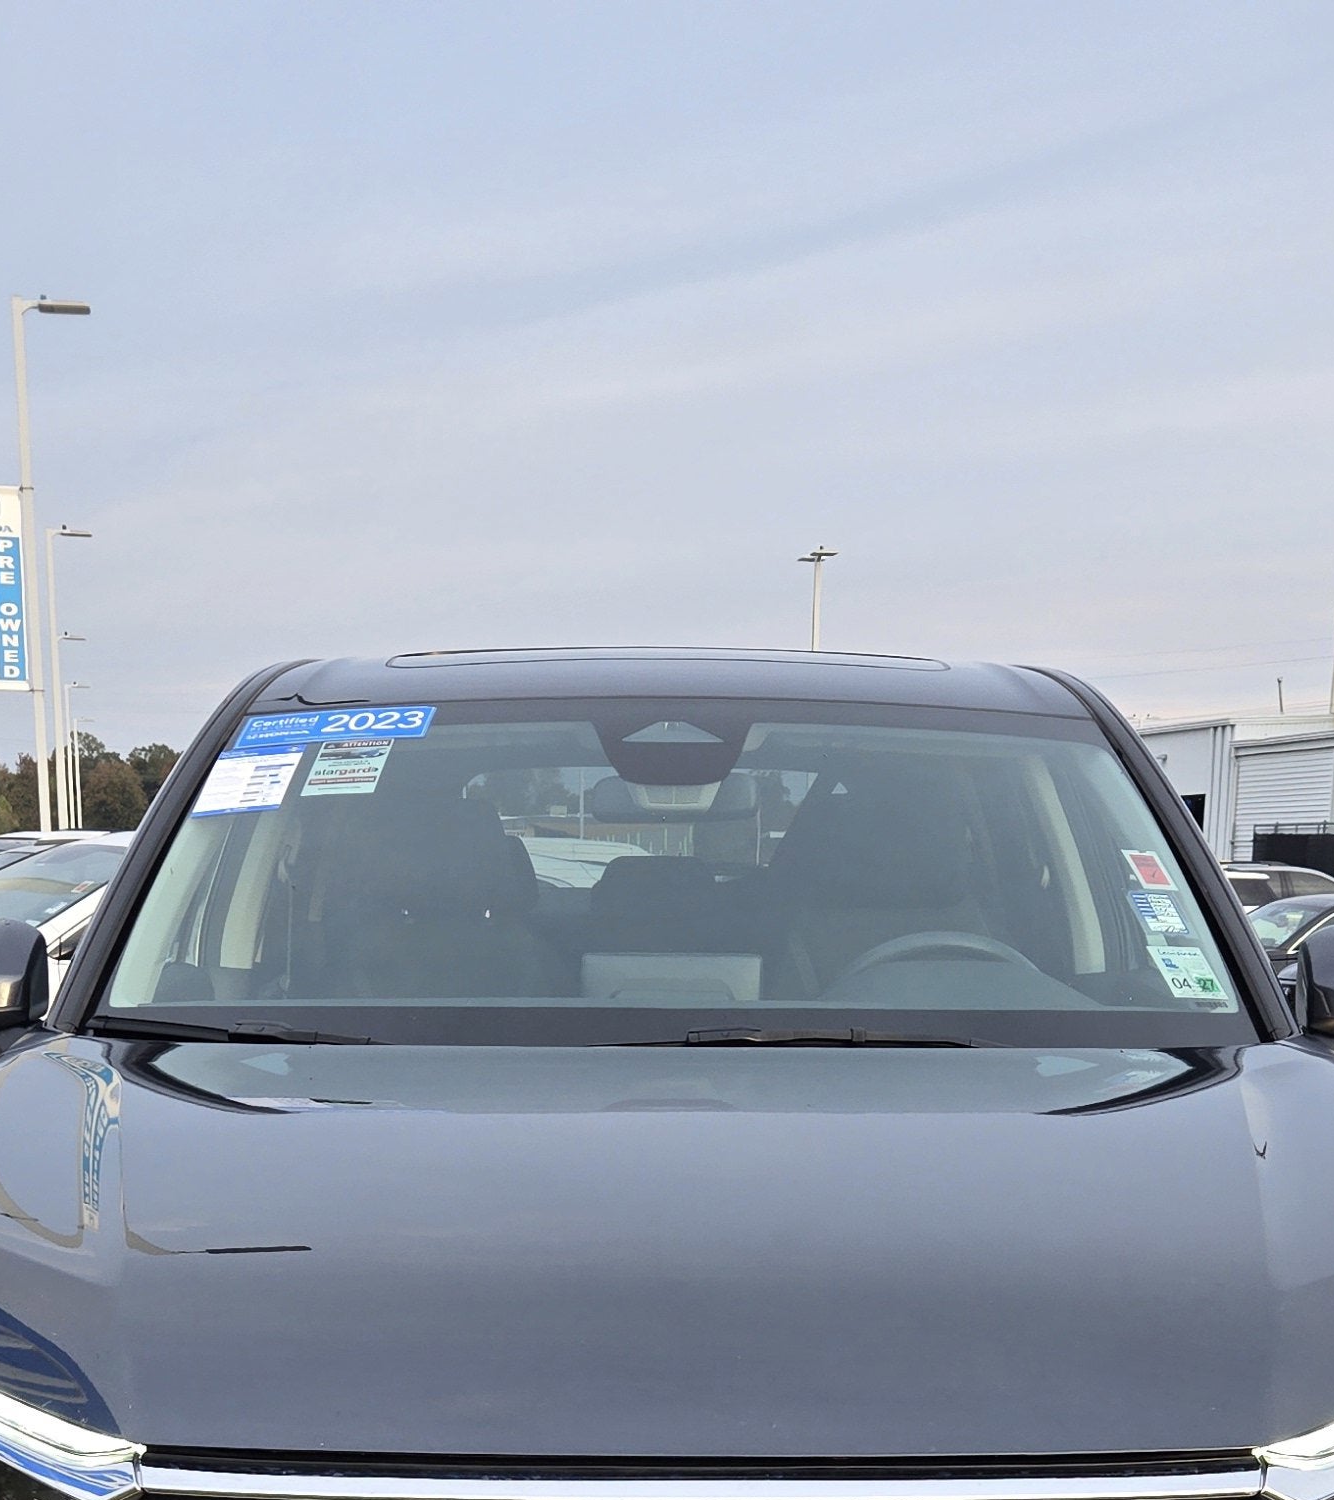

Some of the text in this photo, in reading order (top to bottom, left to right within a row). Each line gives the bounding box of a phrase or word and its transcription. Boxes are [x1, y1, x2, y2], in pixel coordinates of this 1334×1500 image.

[252, 715, 320, 728] Certified
[321, 711, 425, 733] 2023
[342, 740, 389, 748] ATTENTION
[1171, 977, 1192, 990] 04
